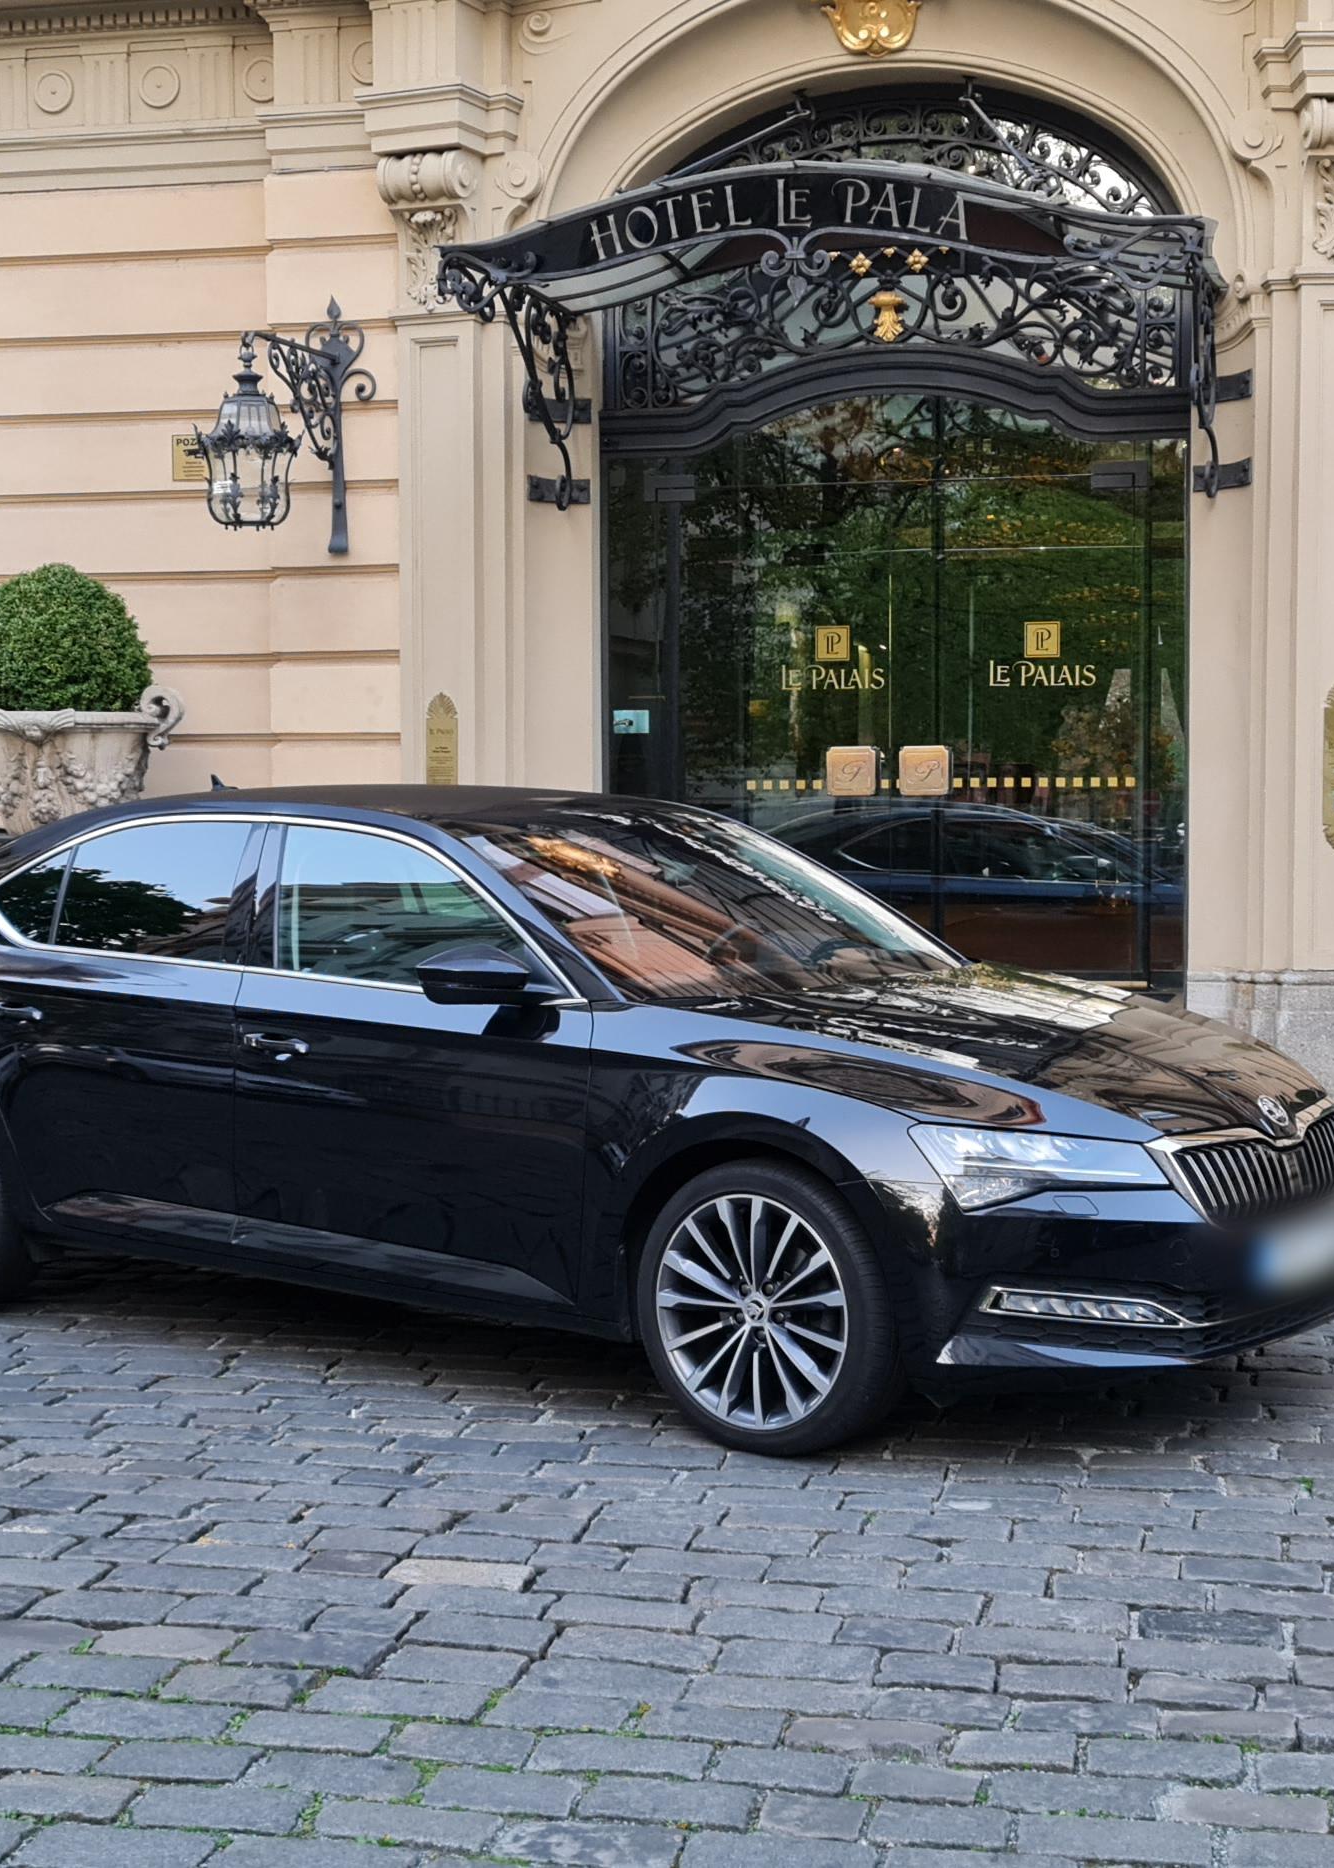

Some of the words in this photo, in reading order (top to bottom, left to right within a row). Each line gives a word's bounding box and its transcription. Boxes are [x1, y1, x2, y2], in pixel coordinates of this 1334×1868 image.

[590, 184, 753, 260] HOTEL
[805, 664, 885, 690] PALAIS
[1012, 660, 1097, 687] PALAIS
